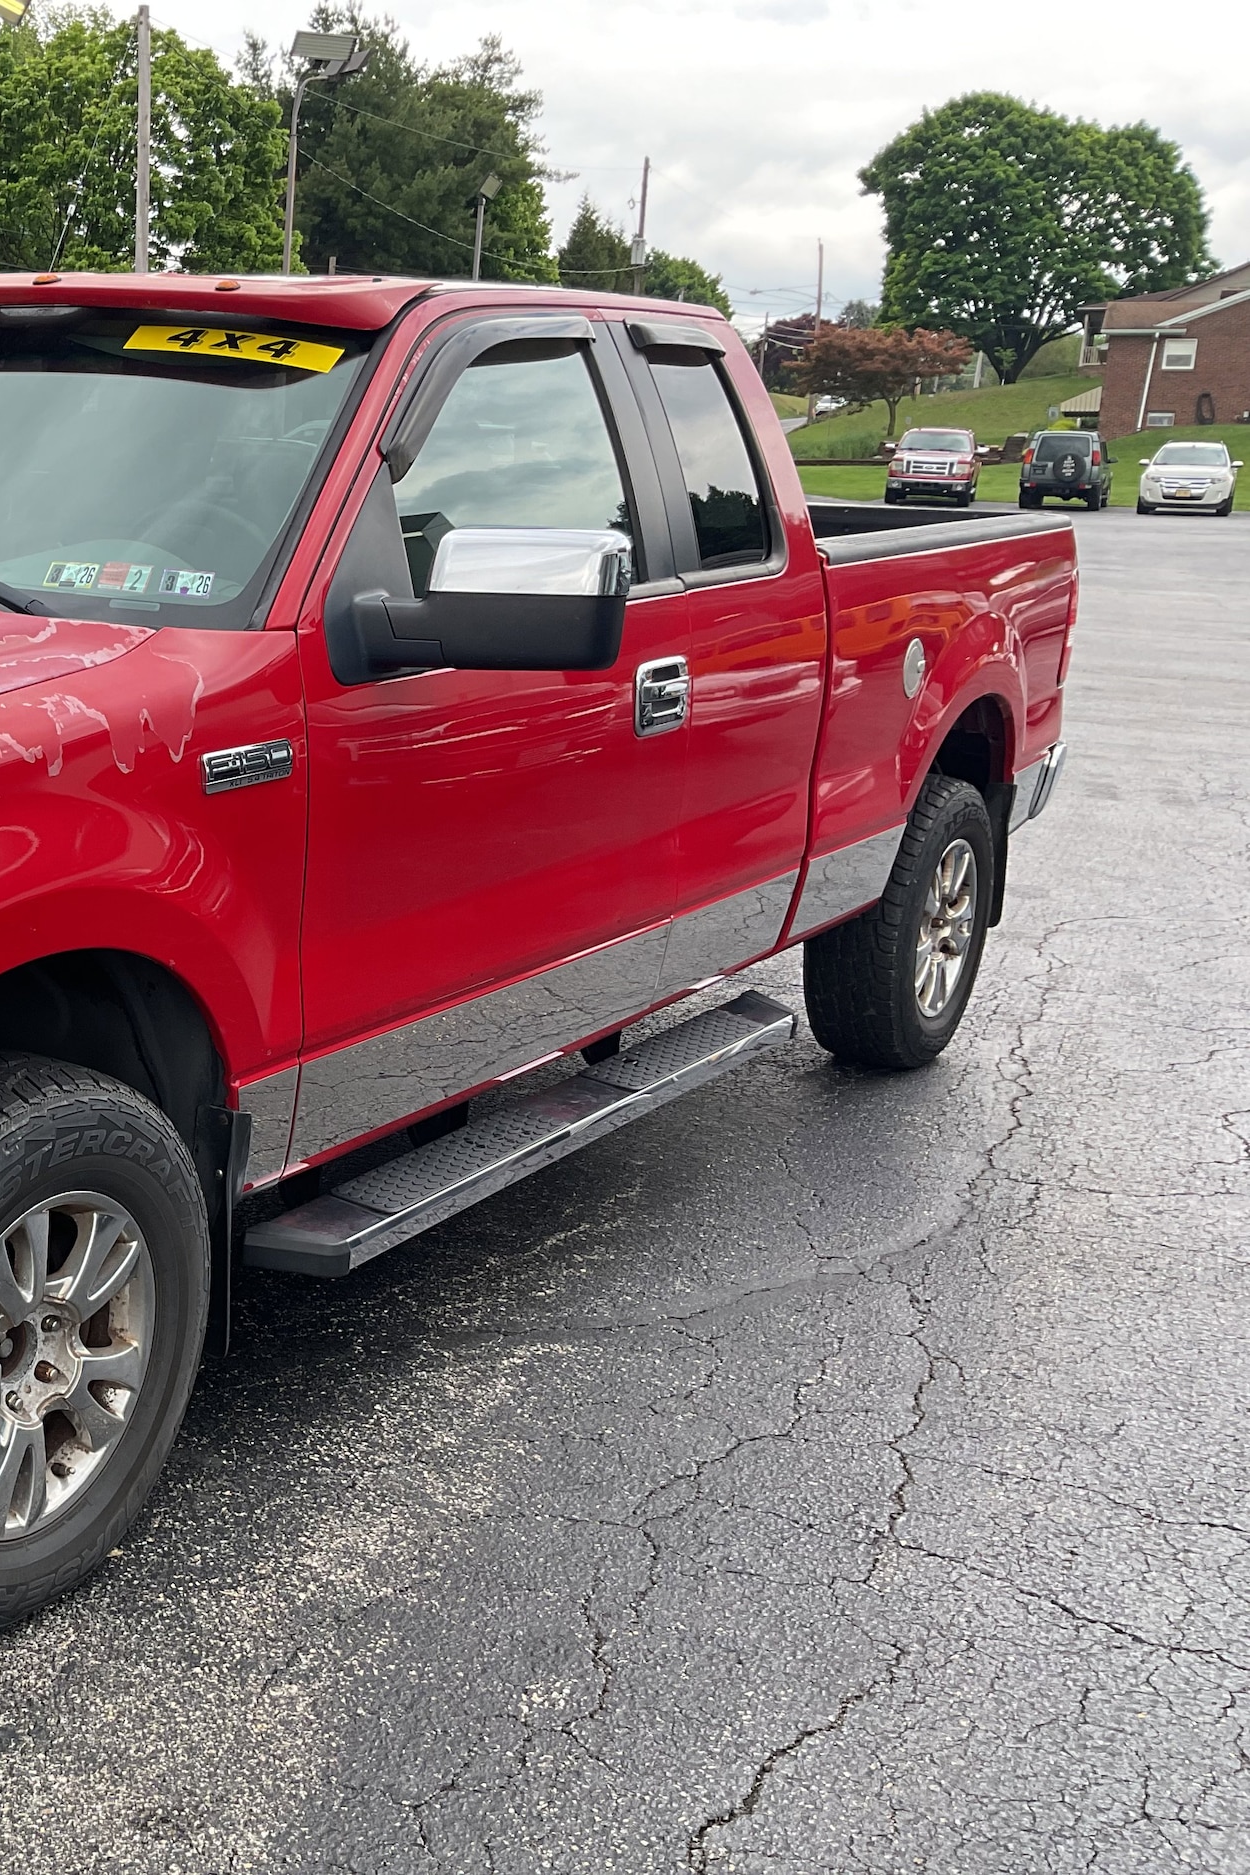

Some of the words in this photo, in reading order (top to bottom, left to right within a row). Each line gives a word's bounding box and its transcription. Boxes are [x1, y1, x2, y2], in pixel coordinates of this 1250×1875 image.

[79, 566, 96, 584] 26
[129, 569, 143, 591] 2
[165, 575, 175, 591] 3
[196, 575, 211, 594] 26
